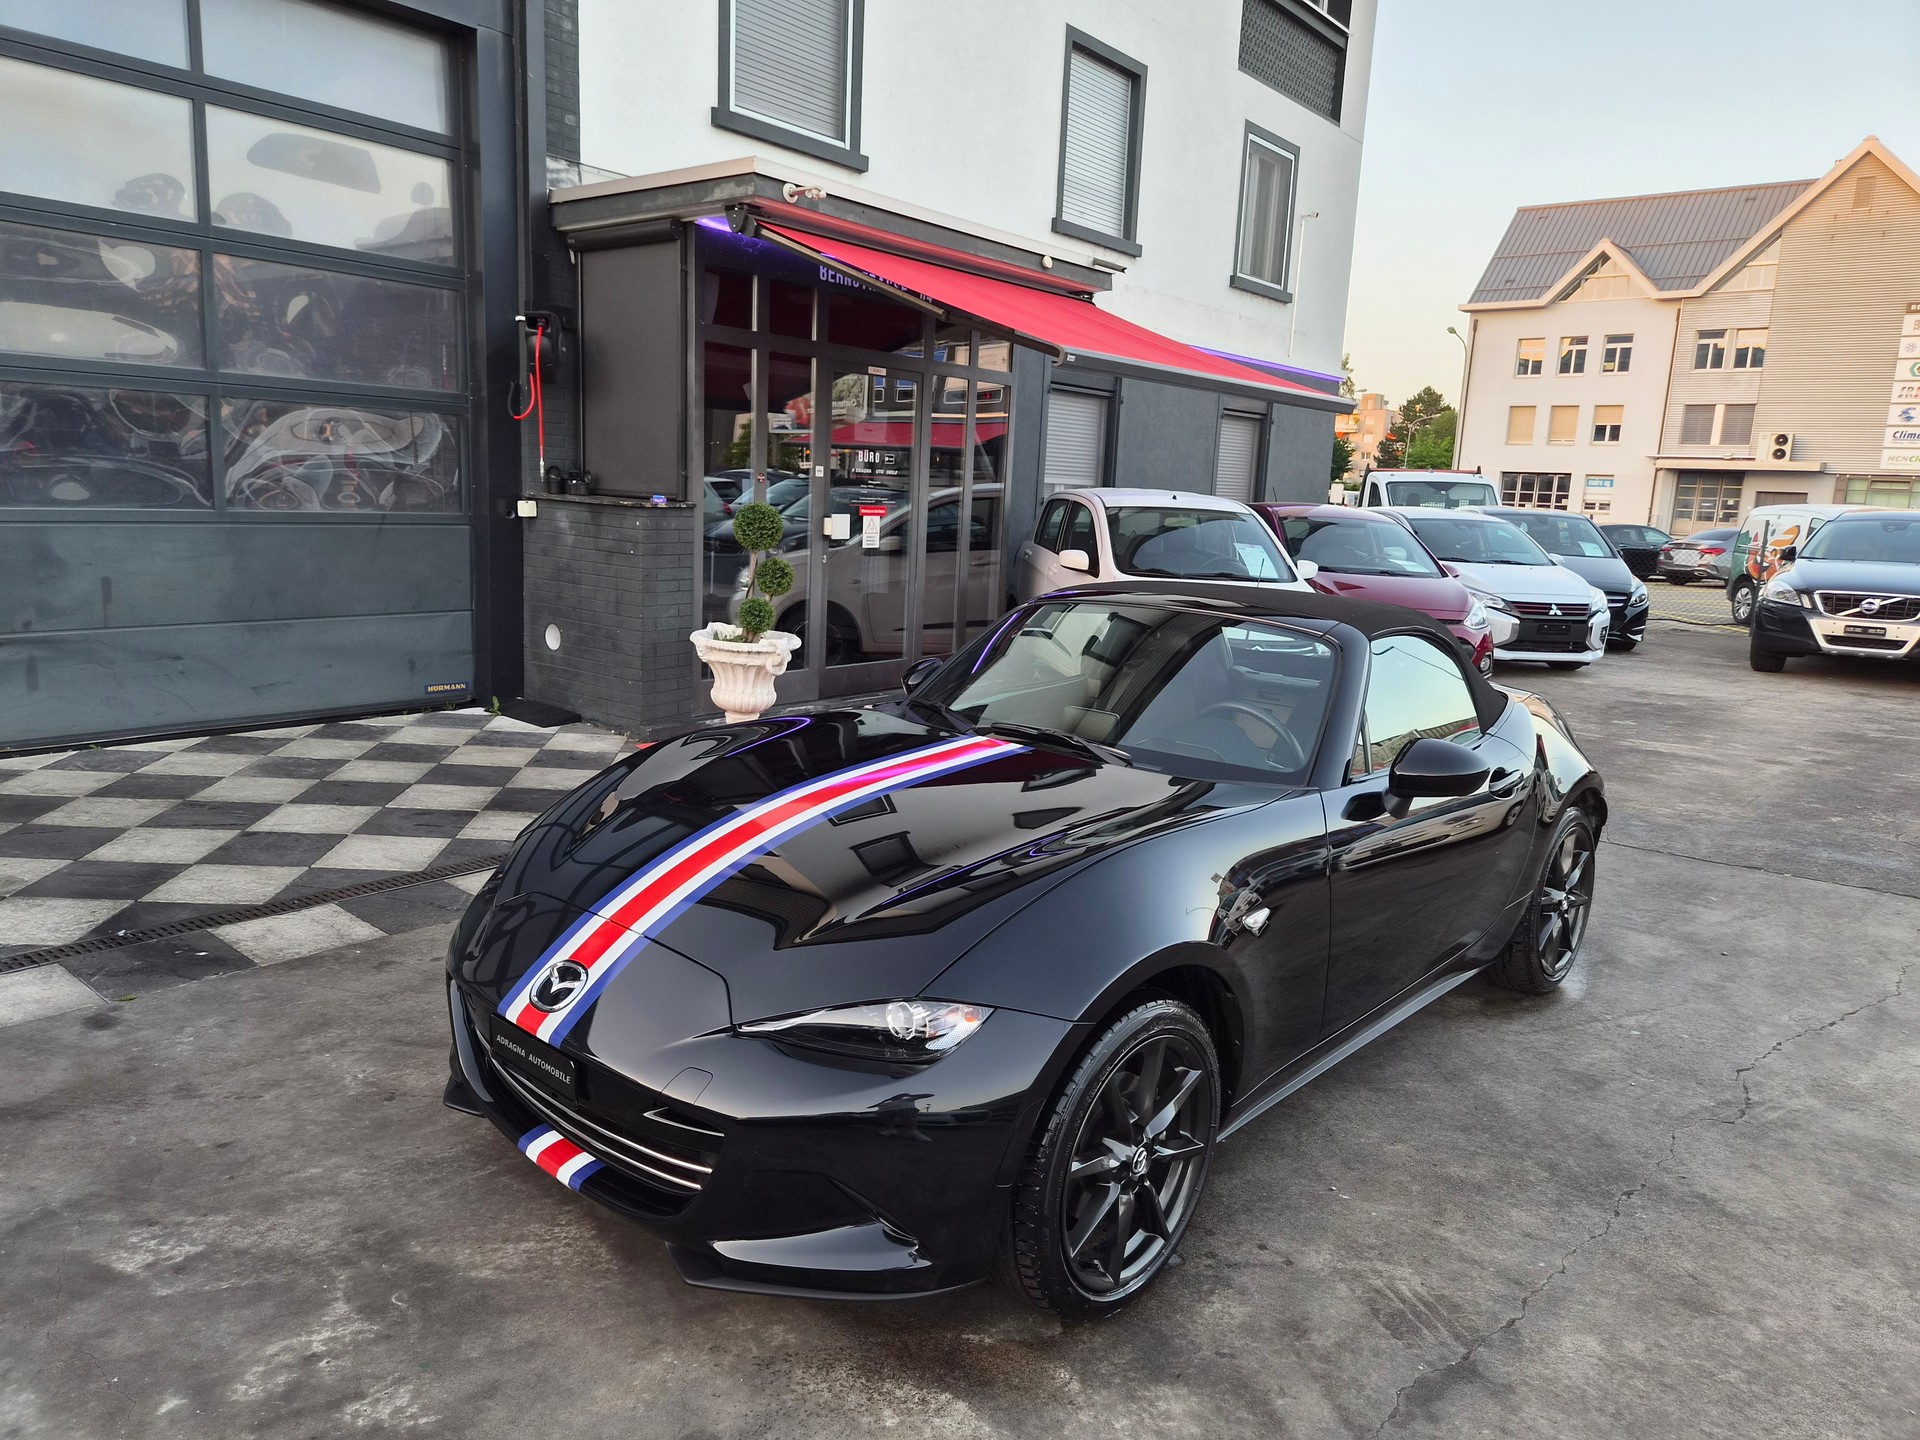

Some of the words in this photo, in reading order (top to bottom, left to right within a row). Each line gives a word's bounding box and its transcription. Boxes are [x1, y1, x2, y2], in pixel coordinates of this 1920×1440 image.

[858, 449, 880, 463] BÜRO
[496, 1034, 526, 1058] ADRAGNA
[528, 1053, 571, 1085] AUTOMOBILE
